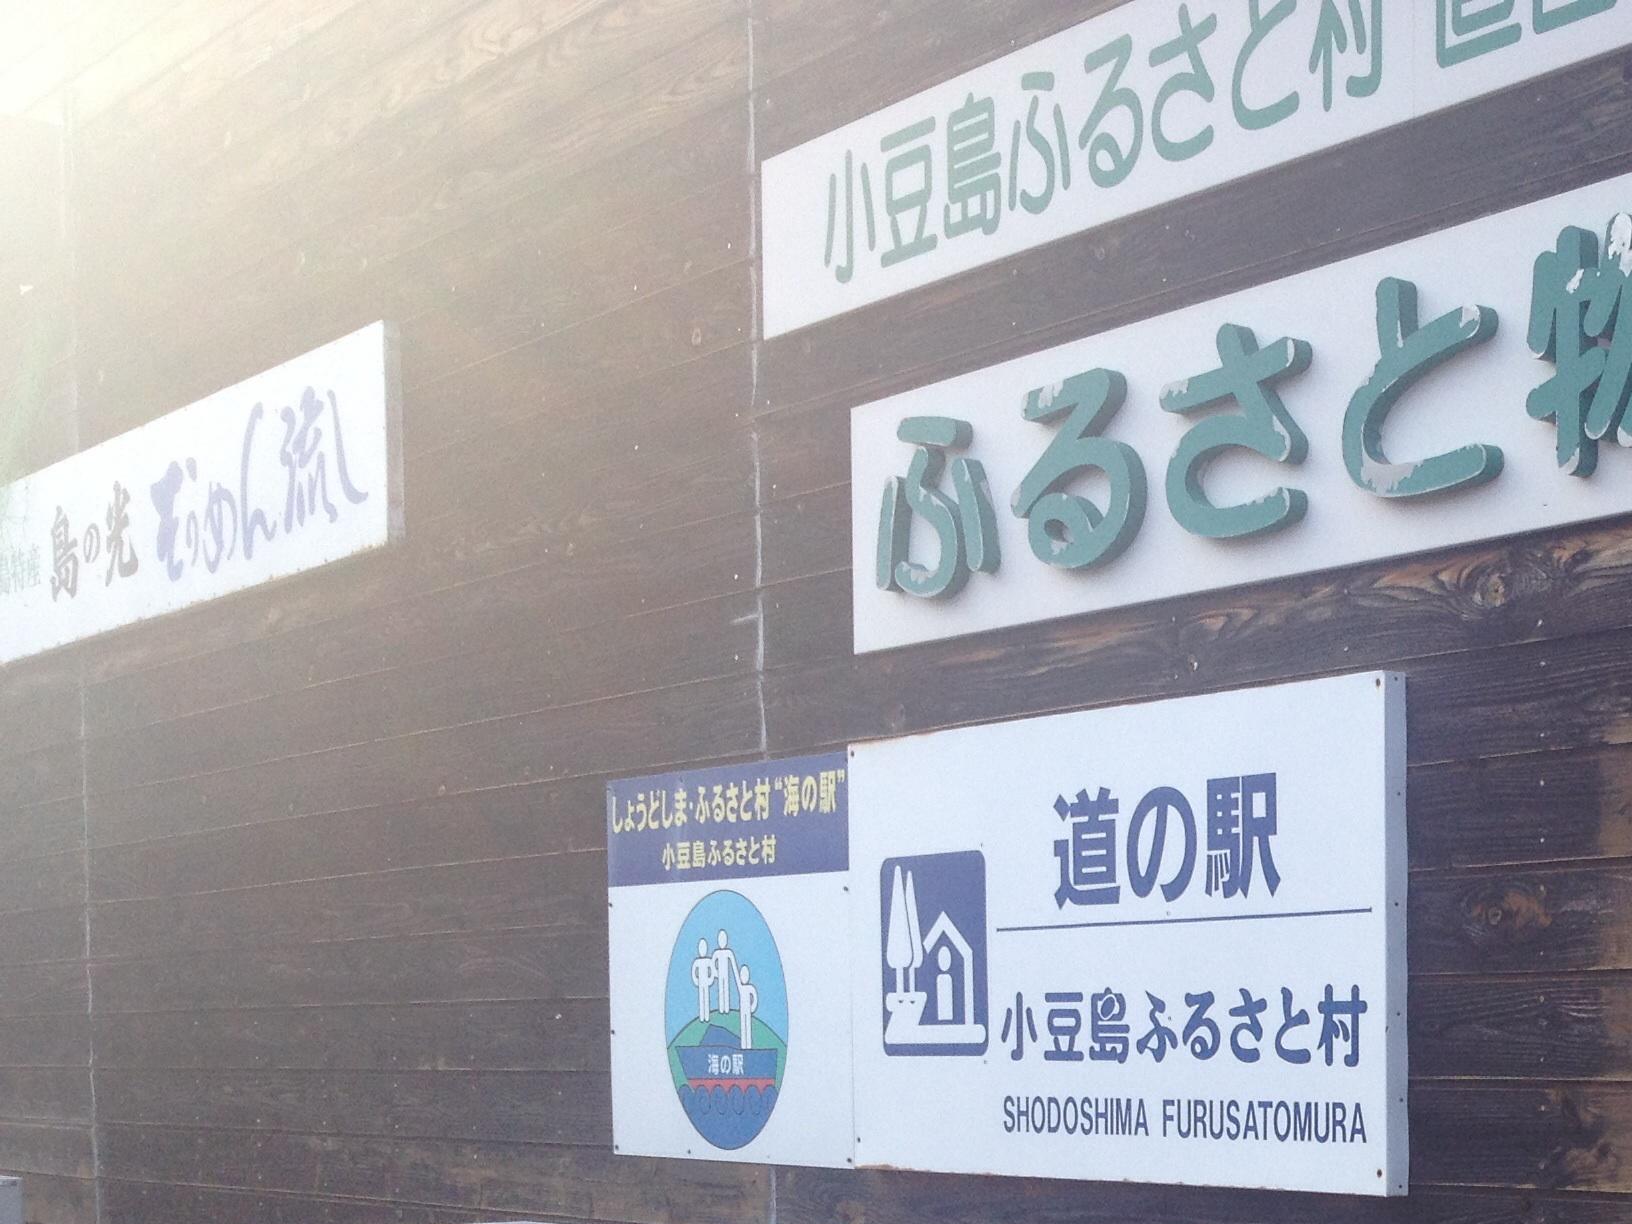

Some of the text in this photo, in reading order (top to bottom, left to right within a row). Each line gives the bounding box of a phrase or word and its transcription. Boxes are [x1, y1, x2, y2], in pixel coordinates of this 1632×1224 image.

[824, 0, 1382, 283] 小豆島ふるさと村
[50, 480, 139, 602] 島の光
[662, 834, 776, 871] 小豆島ふるさと村
[1052, 771, 1282, 911] 道の駅
[708, 1053, 744, 1076] 海の駅
[1000, 983, 1368, 1067] 小豆島ふるさと村
[1002, 1095, 1368, 1144] SHODOSHIMA FURUSATOMURA
